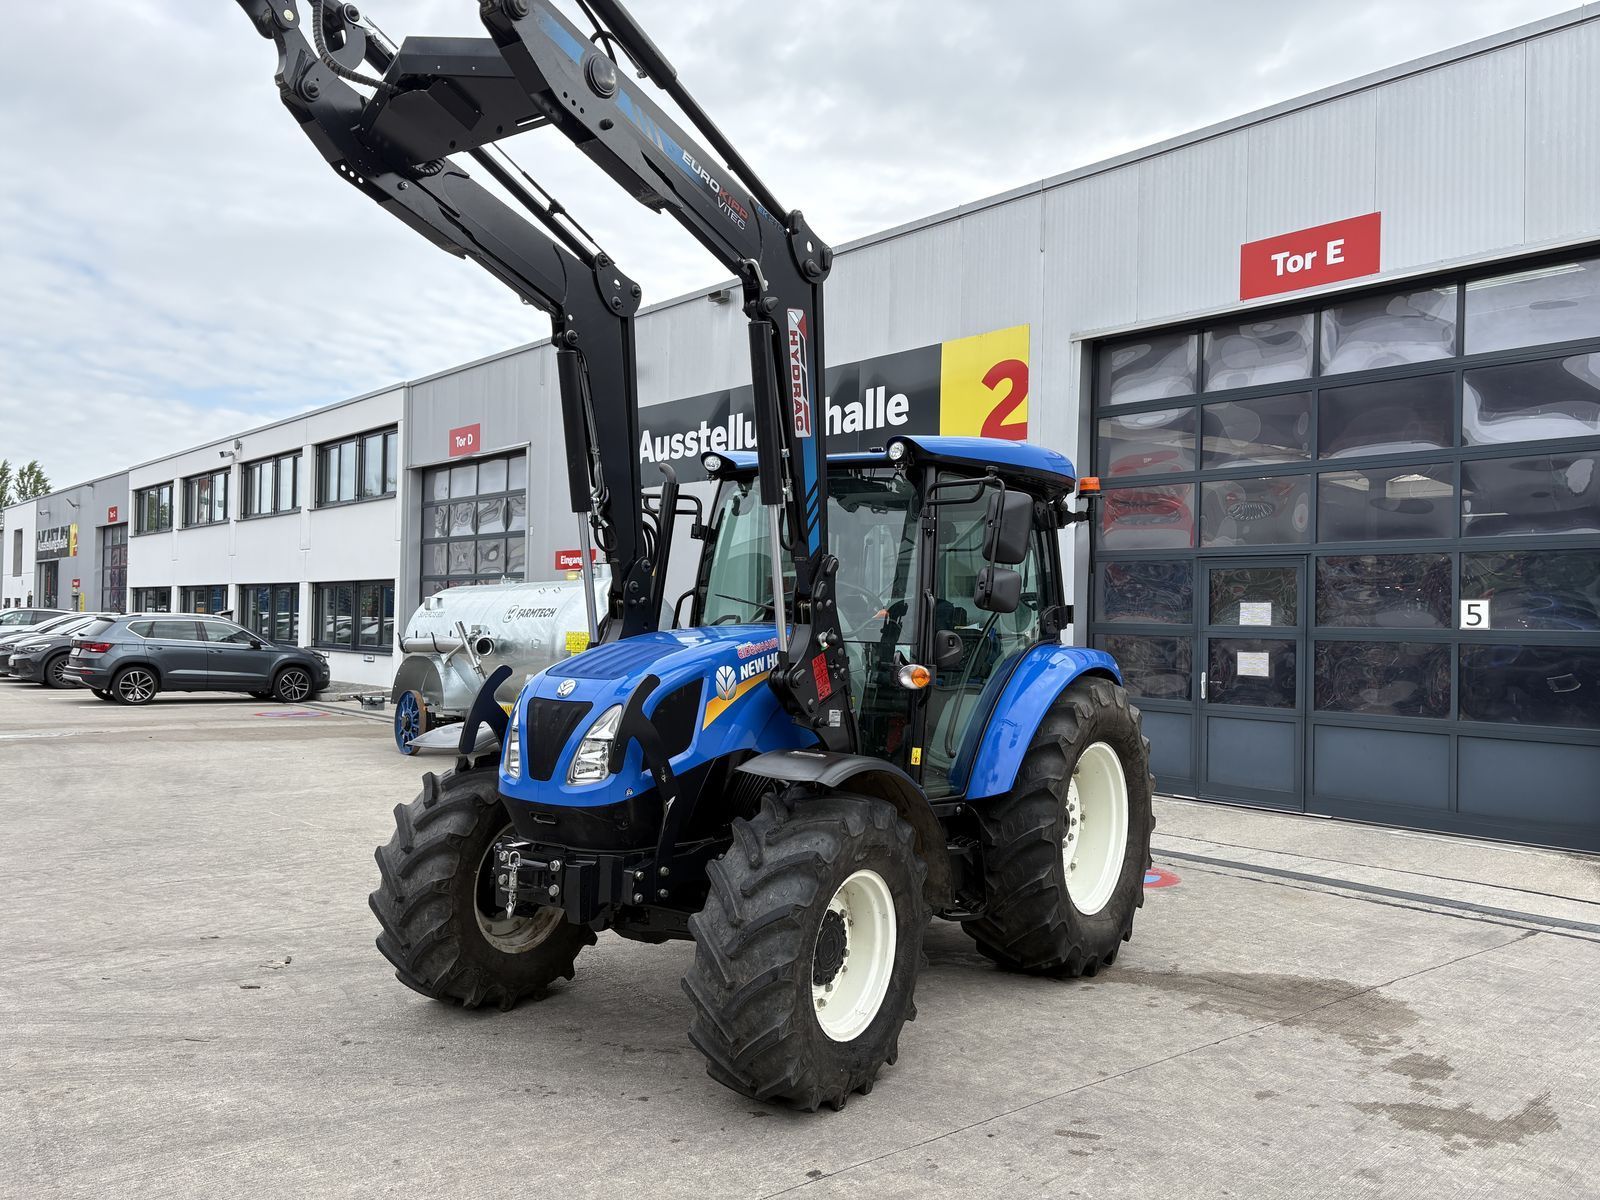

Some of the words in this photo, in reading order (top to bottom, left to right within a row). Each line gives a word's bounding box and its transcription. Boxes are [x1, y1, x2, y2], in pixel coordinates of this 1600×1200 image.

[682, 149, 749, 220] EUROKIPP
[717, 196, 746, 230] VITEC
[1271, 250, 1317, 277] Tor
[1326, 238, 1345, 266] E
[789, 329, 804, 432] HYDRAC
[639, 385, 909, 465] Ausstelluhalle
[980, 358, 1029, 441] 2
[455, 435, 467, 448] Tor
[467, 433, 473, 446] D
[516, 607, 558, 621] FARMTECH
[1466, 603, 1482, 626] 5
[740, 656, 765, 681] NEW
